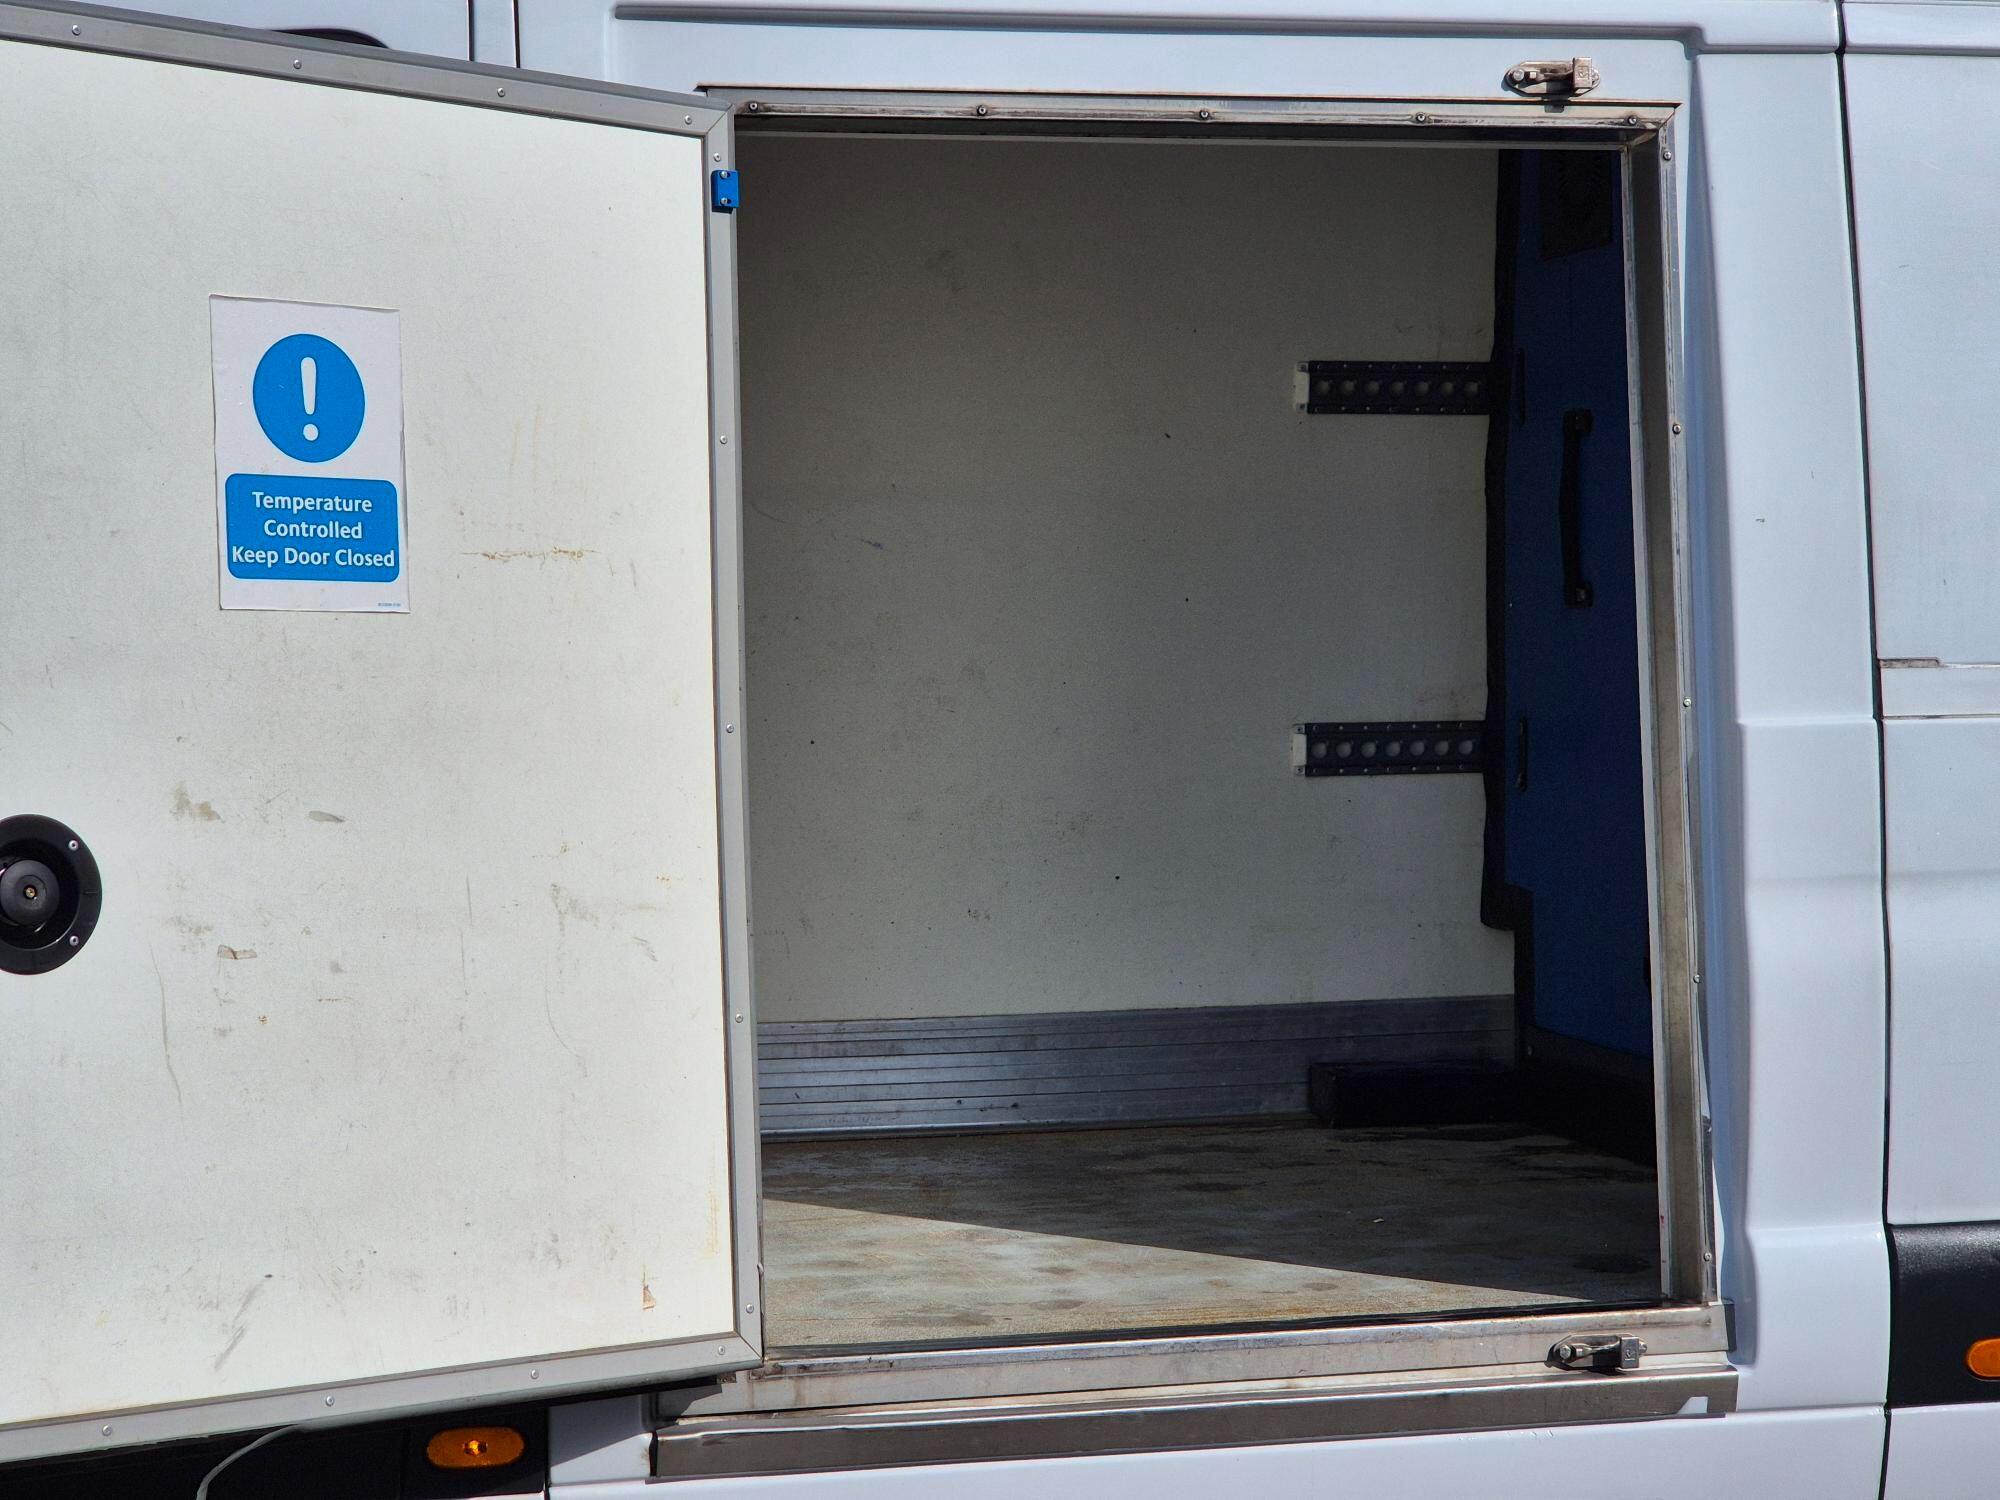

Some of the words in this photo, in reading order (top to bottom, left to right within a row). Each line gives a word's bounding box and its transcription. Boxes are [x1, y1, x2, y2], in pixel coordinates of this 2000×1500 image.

[252, 491, 372, 513] Temperature
[263, 519, 363, 539] Controlled
[232, 545, 279, 567] Keep
[284, 547, 330, 565] Door
[334, 549, 395, 567] Closed
